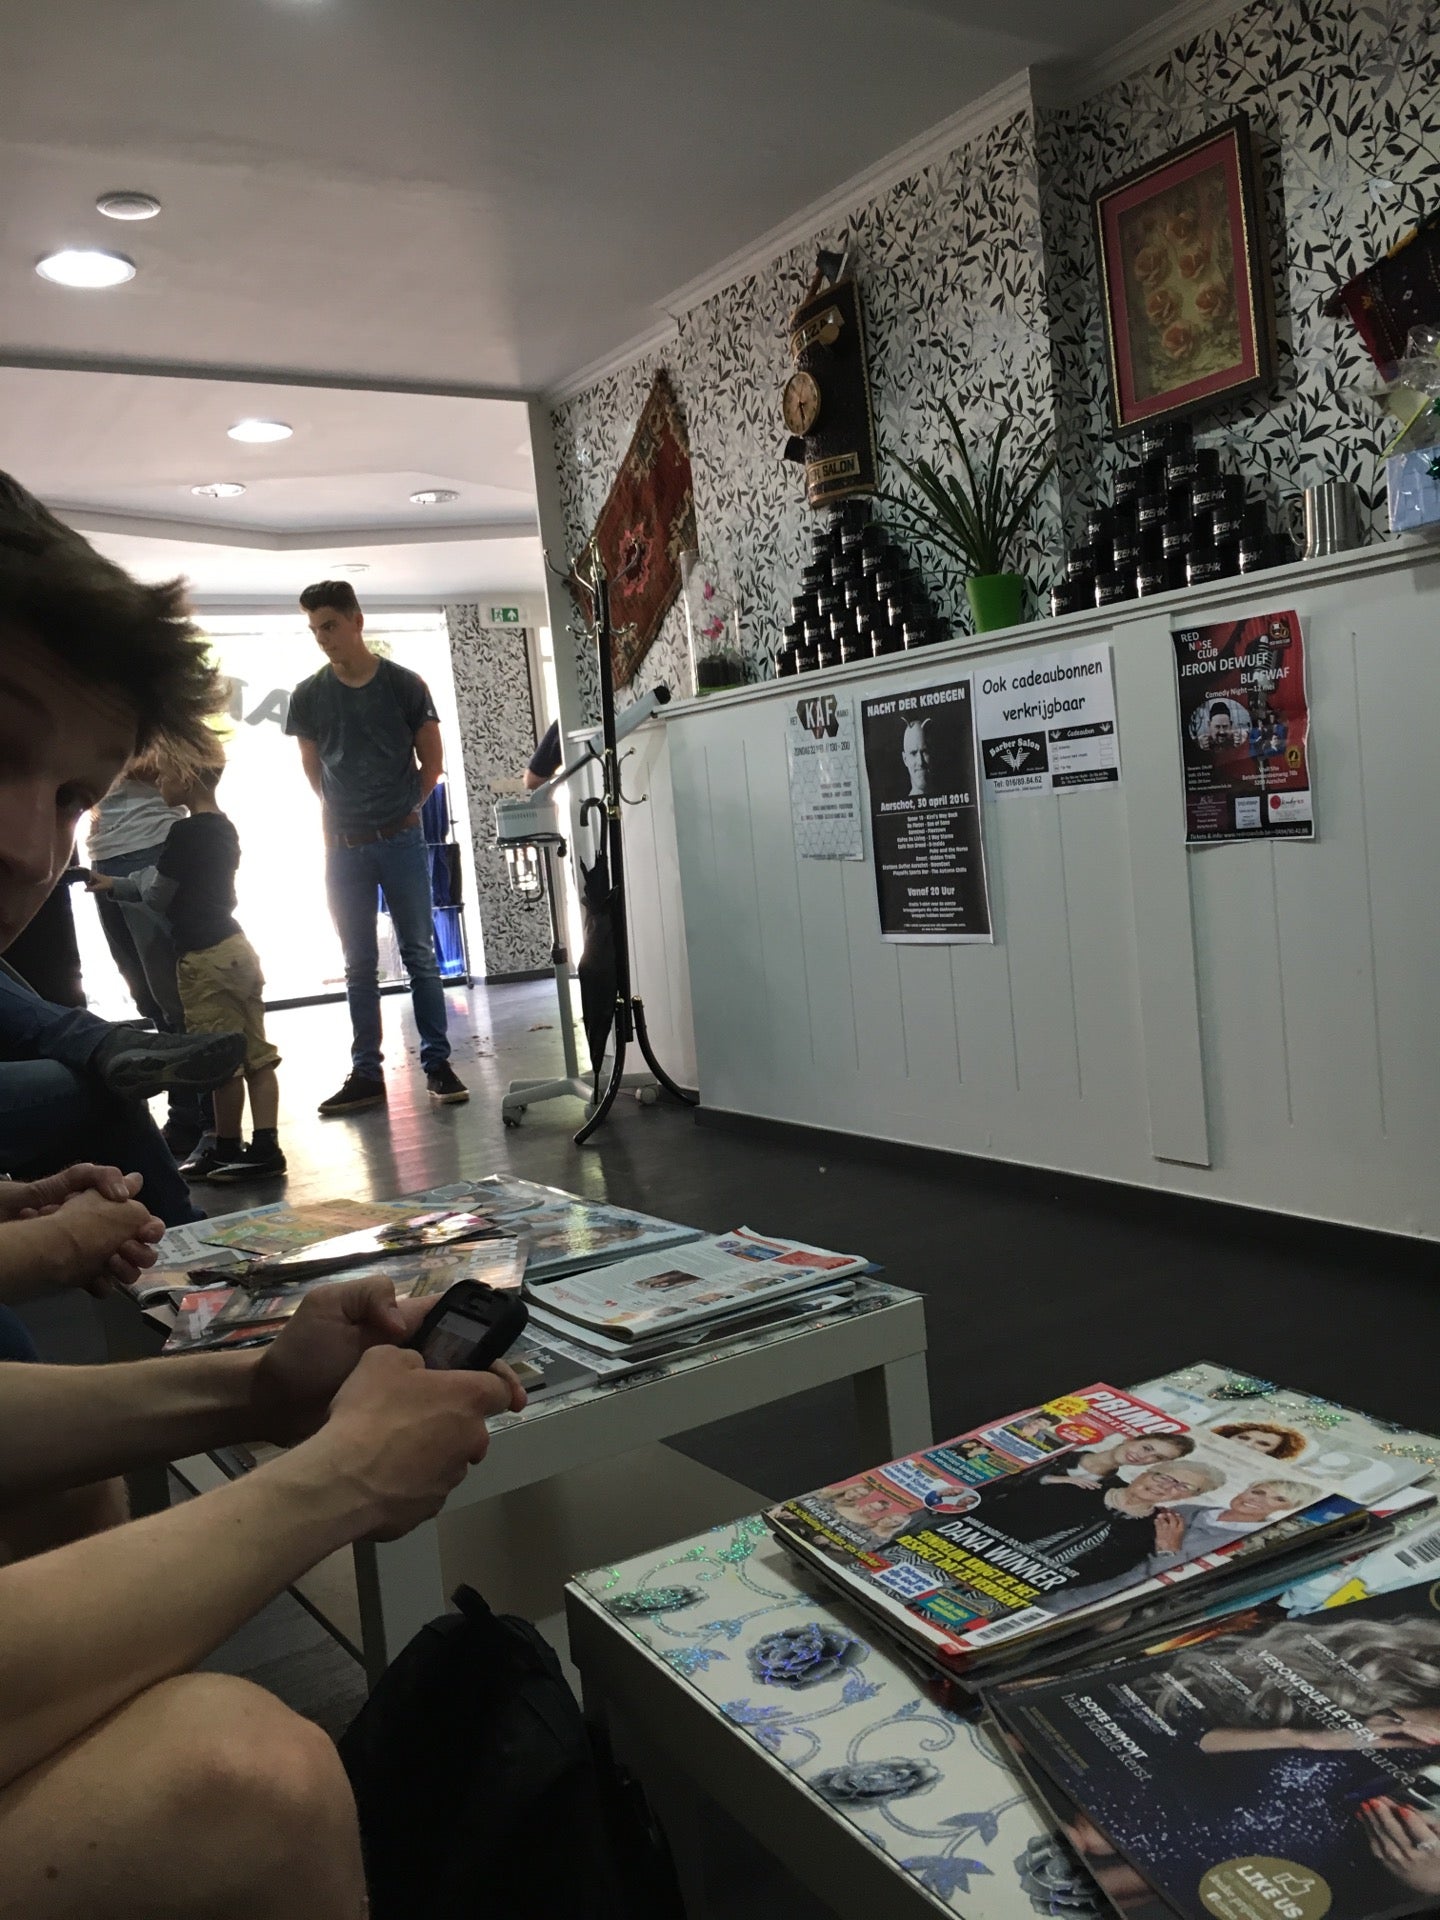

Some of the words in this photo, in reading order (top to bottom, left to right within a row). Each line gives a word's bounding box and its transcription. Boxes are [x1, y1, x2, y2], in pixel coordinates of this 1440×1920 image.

[823, 459, 855, 477] SALON
[1180, 631, 1199, 643] RED
[1197, 647, 1219, 659] CLUB
[982, 676, 1007, 695] Ook
[1012, 661, 1103, 690] cadeaubonnen
[1181, 660, 1217, 677] JERON
[805, 699, 833, 729] KAF
[867, 701, 896, 717] NACHT
[898, 697, 917, 711] DER
[920, 688, 965, 708] KROEGEN
[1002, 697, 1086, 721] verkrijgbaar
[989, 739, 1016, 758] Barber
[1017, 737, 1041, 751] Salon
[881, 800, 916, 811] Aarschot,
[917, 798, 927, 808] 30
[929, 795, 948, 807] april
[949, 793, 970, 804] 2016
[907, 887, 928, 896] Vanaf
[930, 886, 939, 896] 20
[942, 886, 955, 895] Uur
[1080, 1390, 1181, 1434] PRIMO
[802, 1498, 831, 1521] Miette
[828, 1516, 840, 1527] &
[835, 1522, 868, 1545] zussen
[896, 1535, 945, 1562] RESPECT
[935, 1557, 962, 1572] DAT
[956, 1568, 977, 1581] ZE
[936, 1520, 994, 1552] DANA
[983, 1544, 1067, 1591] WINNER
[967, 1553, 1005, 1580] KRIJGT
[1001, 1574, 1018, 1587] ZE
[1014, 1582, 1041, 1598] HET
[1257, 1649, 1331, 1705] VERONIQUE
[1322, 1702, 1379, 1743] LEYSEN
[1061, 1693, 1095, 1717] haar
[1086, 1720, 1127, 1752] ideale
[1119, 1753, 1153, 1782] kerst
[1079, 1695, 1112, 1723] SOFIE
[1105, 1721, 1148, 1759] DUMONT
[1236, 1865, 1282, 1900] LIKE
[1274, 1898, 1303, 1918] US
